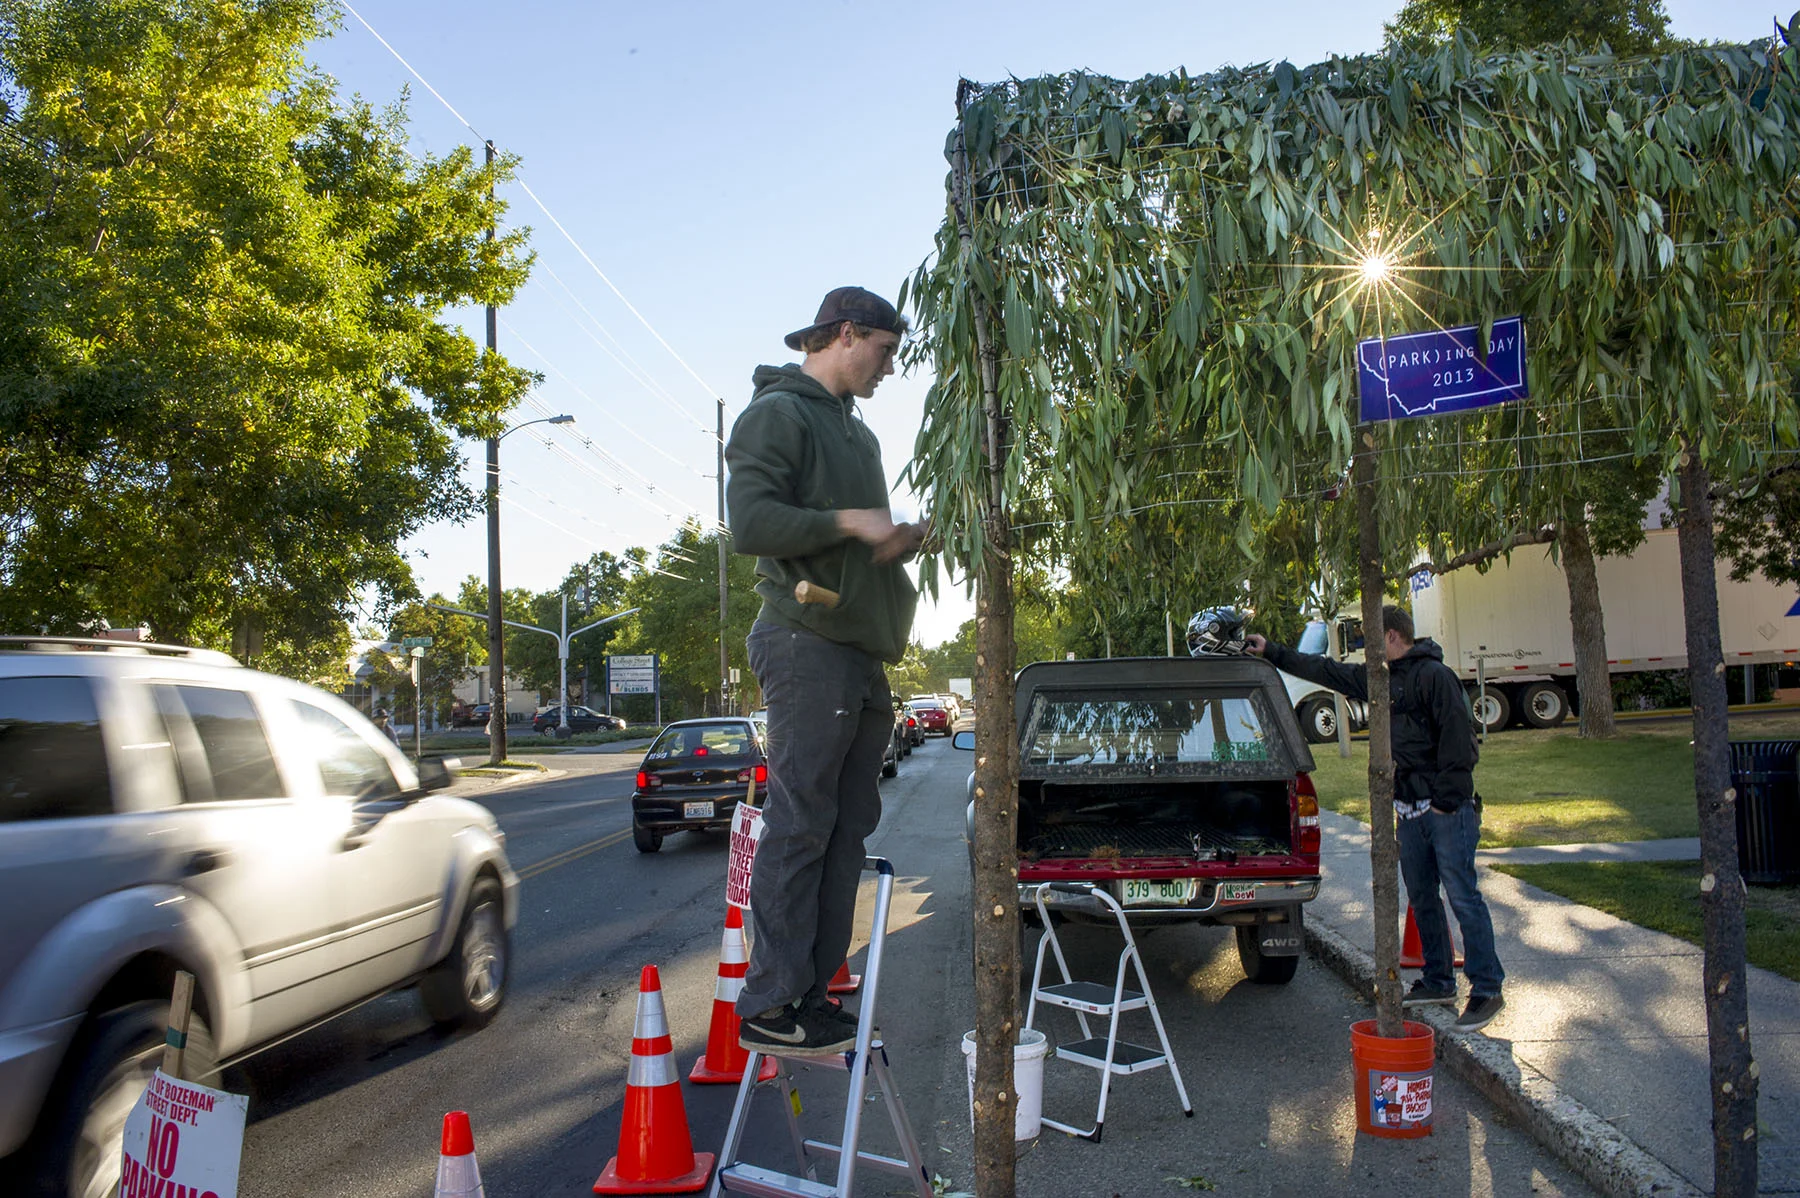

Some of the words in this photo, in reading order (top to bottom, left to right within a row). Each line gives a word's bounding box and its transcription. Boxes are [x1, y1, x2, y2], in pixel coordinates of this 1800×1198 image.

[1379, 347, 1475, 371] (PARK)ING
[1488, 336, 1515, 354] DAY
[1433, 368, 1474, 387] 2013
[740, 818, 752, 837] NO
[1262, 937, 1300, 948] 4WD
[145, 1089, 169, 1118] STREET
[170, 1102, 199, 1127] DEPT.
[155, 1077, 166, 1096] OF
[165, 1082, 215, 1113] BOZEMAN
[146, 1113, 180, 1179] NO
